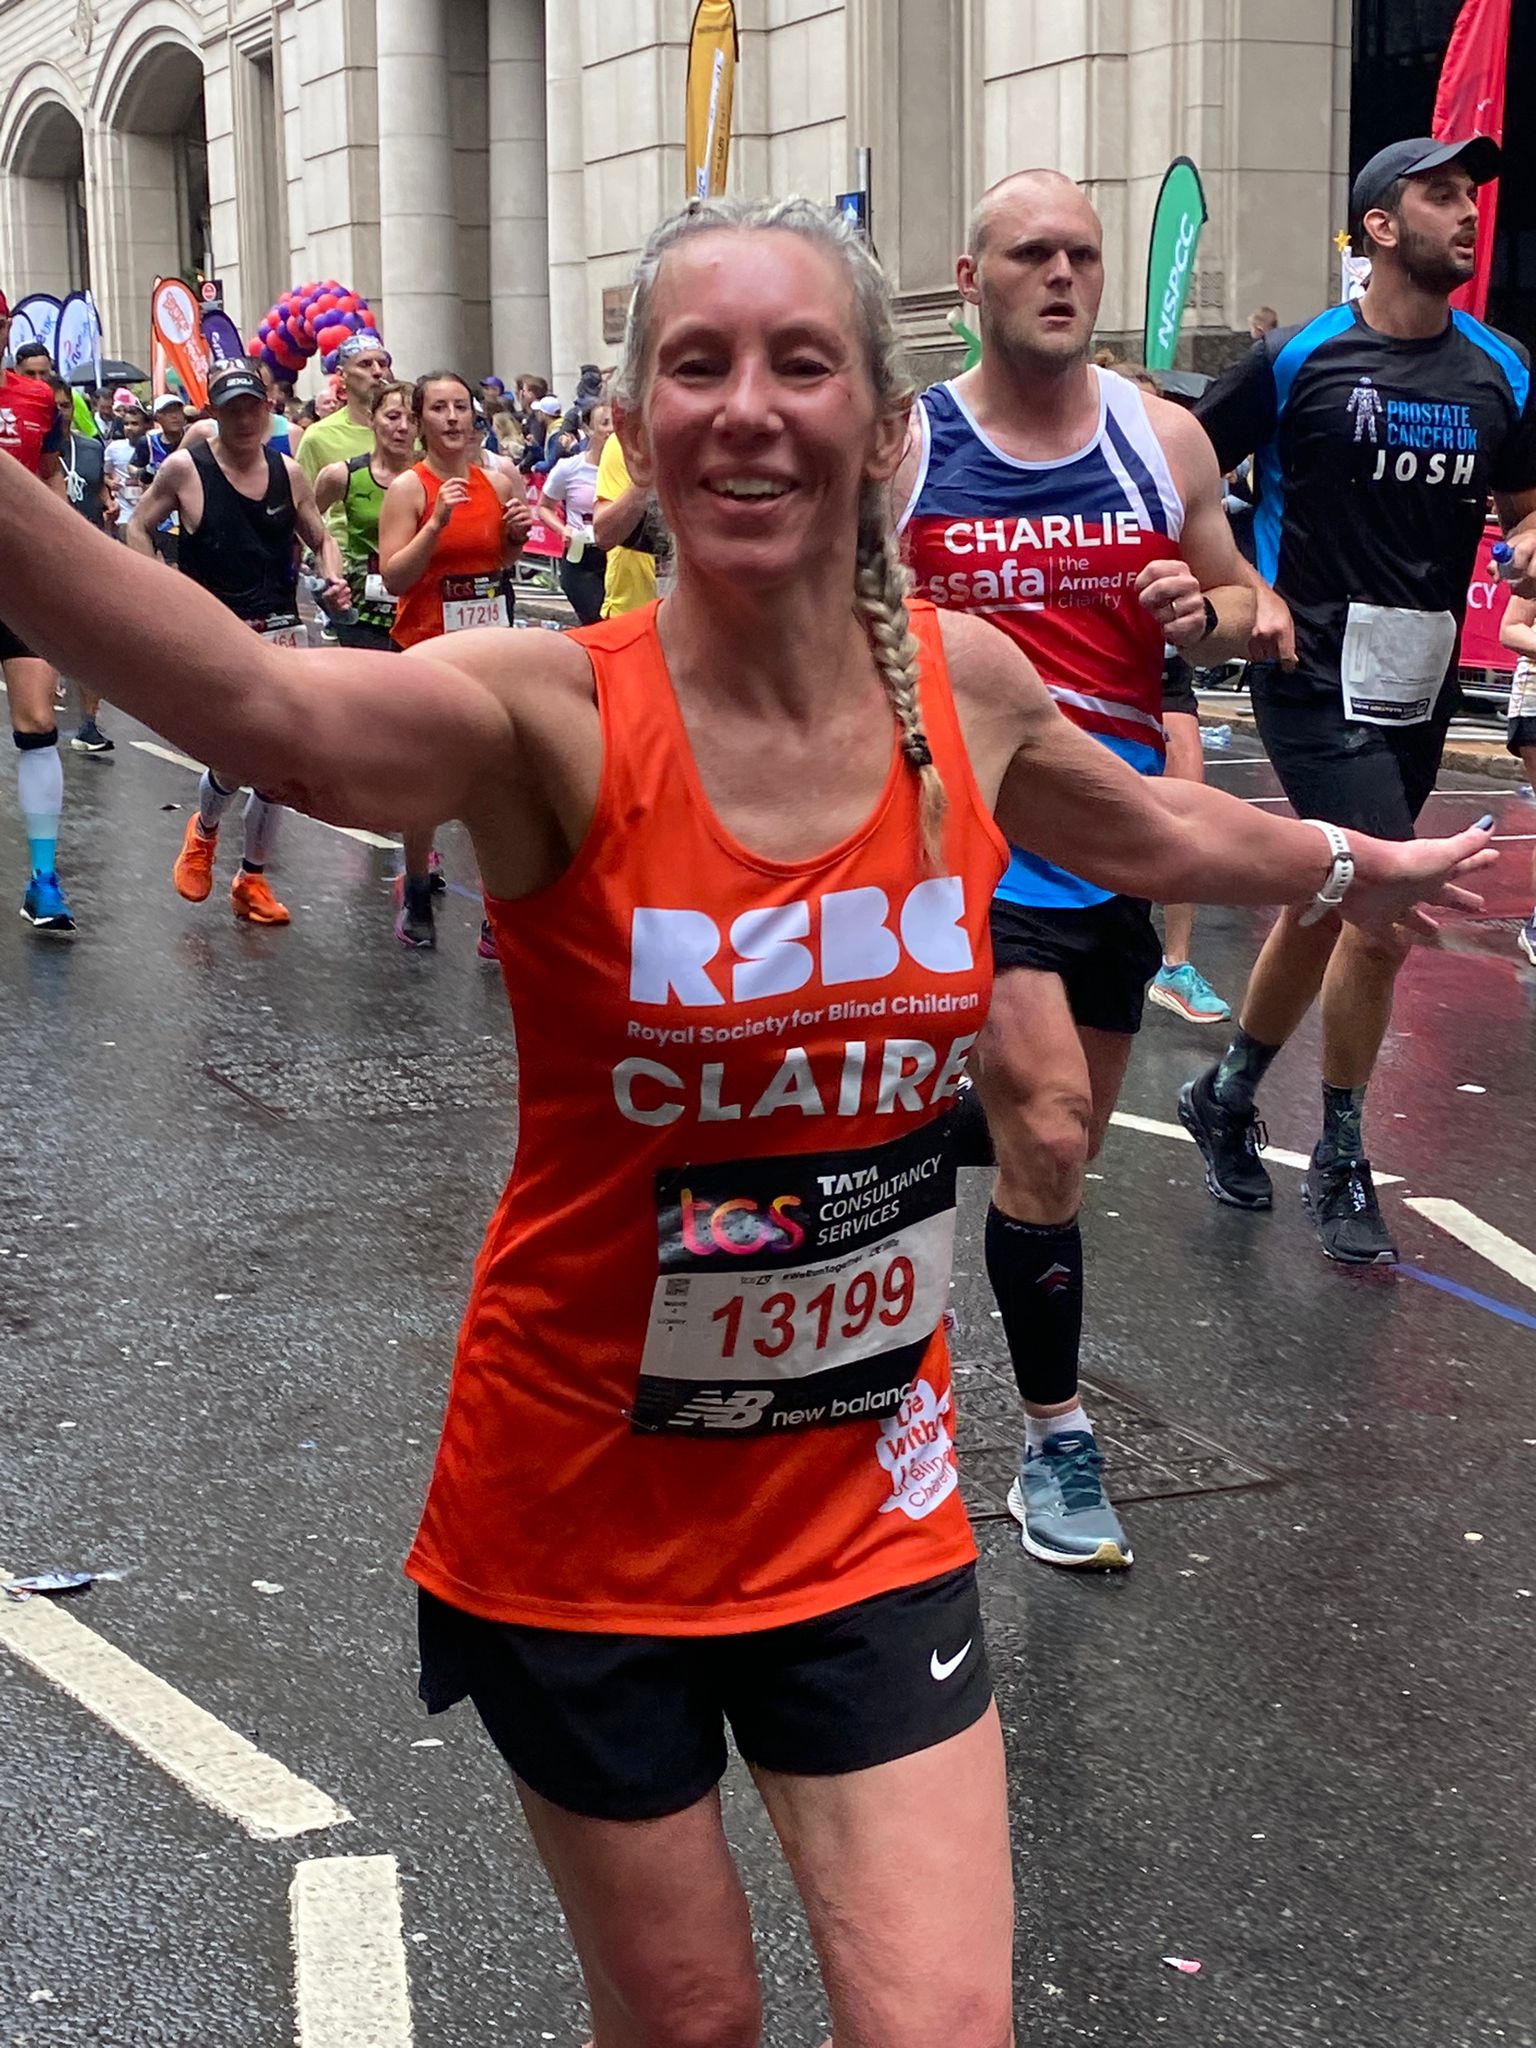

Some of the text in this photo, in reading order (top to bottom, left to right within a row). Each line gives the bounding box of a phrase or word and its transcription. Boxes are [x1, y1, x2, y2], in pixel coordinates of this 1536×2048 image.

[1158, 212, 1194, 349] NSPCC
[1387, 400, 1471, 428] PROSTATE
[1387, 422, 1478, 451] CANCER UK
[1372, 449, 1475, 485] JOSH
[944, 511, 1141, 554] CHARLIE
[929, 559, 1045, 604] ssafa
[1058, 555, 1090, 571] the
[1058, 572, 1122, 591] Armed
[1466, 581, 1498, 609] CY
[628, 875, 974, 1007] RSBC
[627, 991, 979, 1048] Royal Society for Blind Children
[611, 1031, 980, 1128] CLAIRE
[817, 1165, 880, 1196] TATA
[819, 1153, 943, 1222] CONSULTANCY
[680, 1187, 808, 1257] tcs
[816, 1199, 901, 1247] SERVICES
[711, 1255, 916, 1359] 13199
[772, 1405, 826, 1428] new
[830, 1382, 912, 1418] balanc
